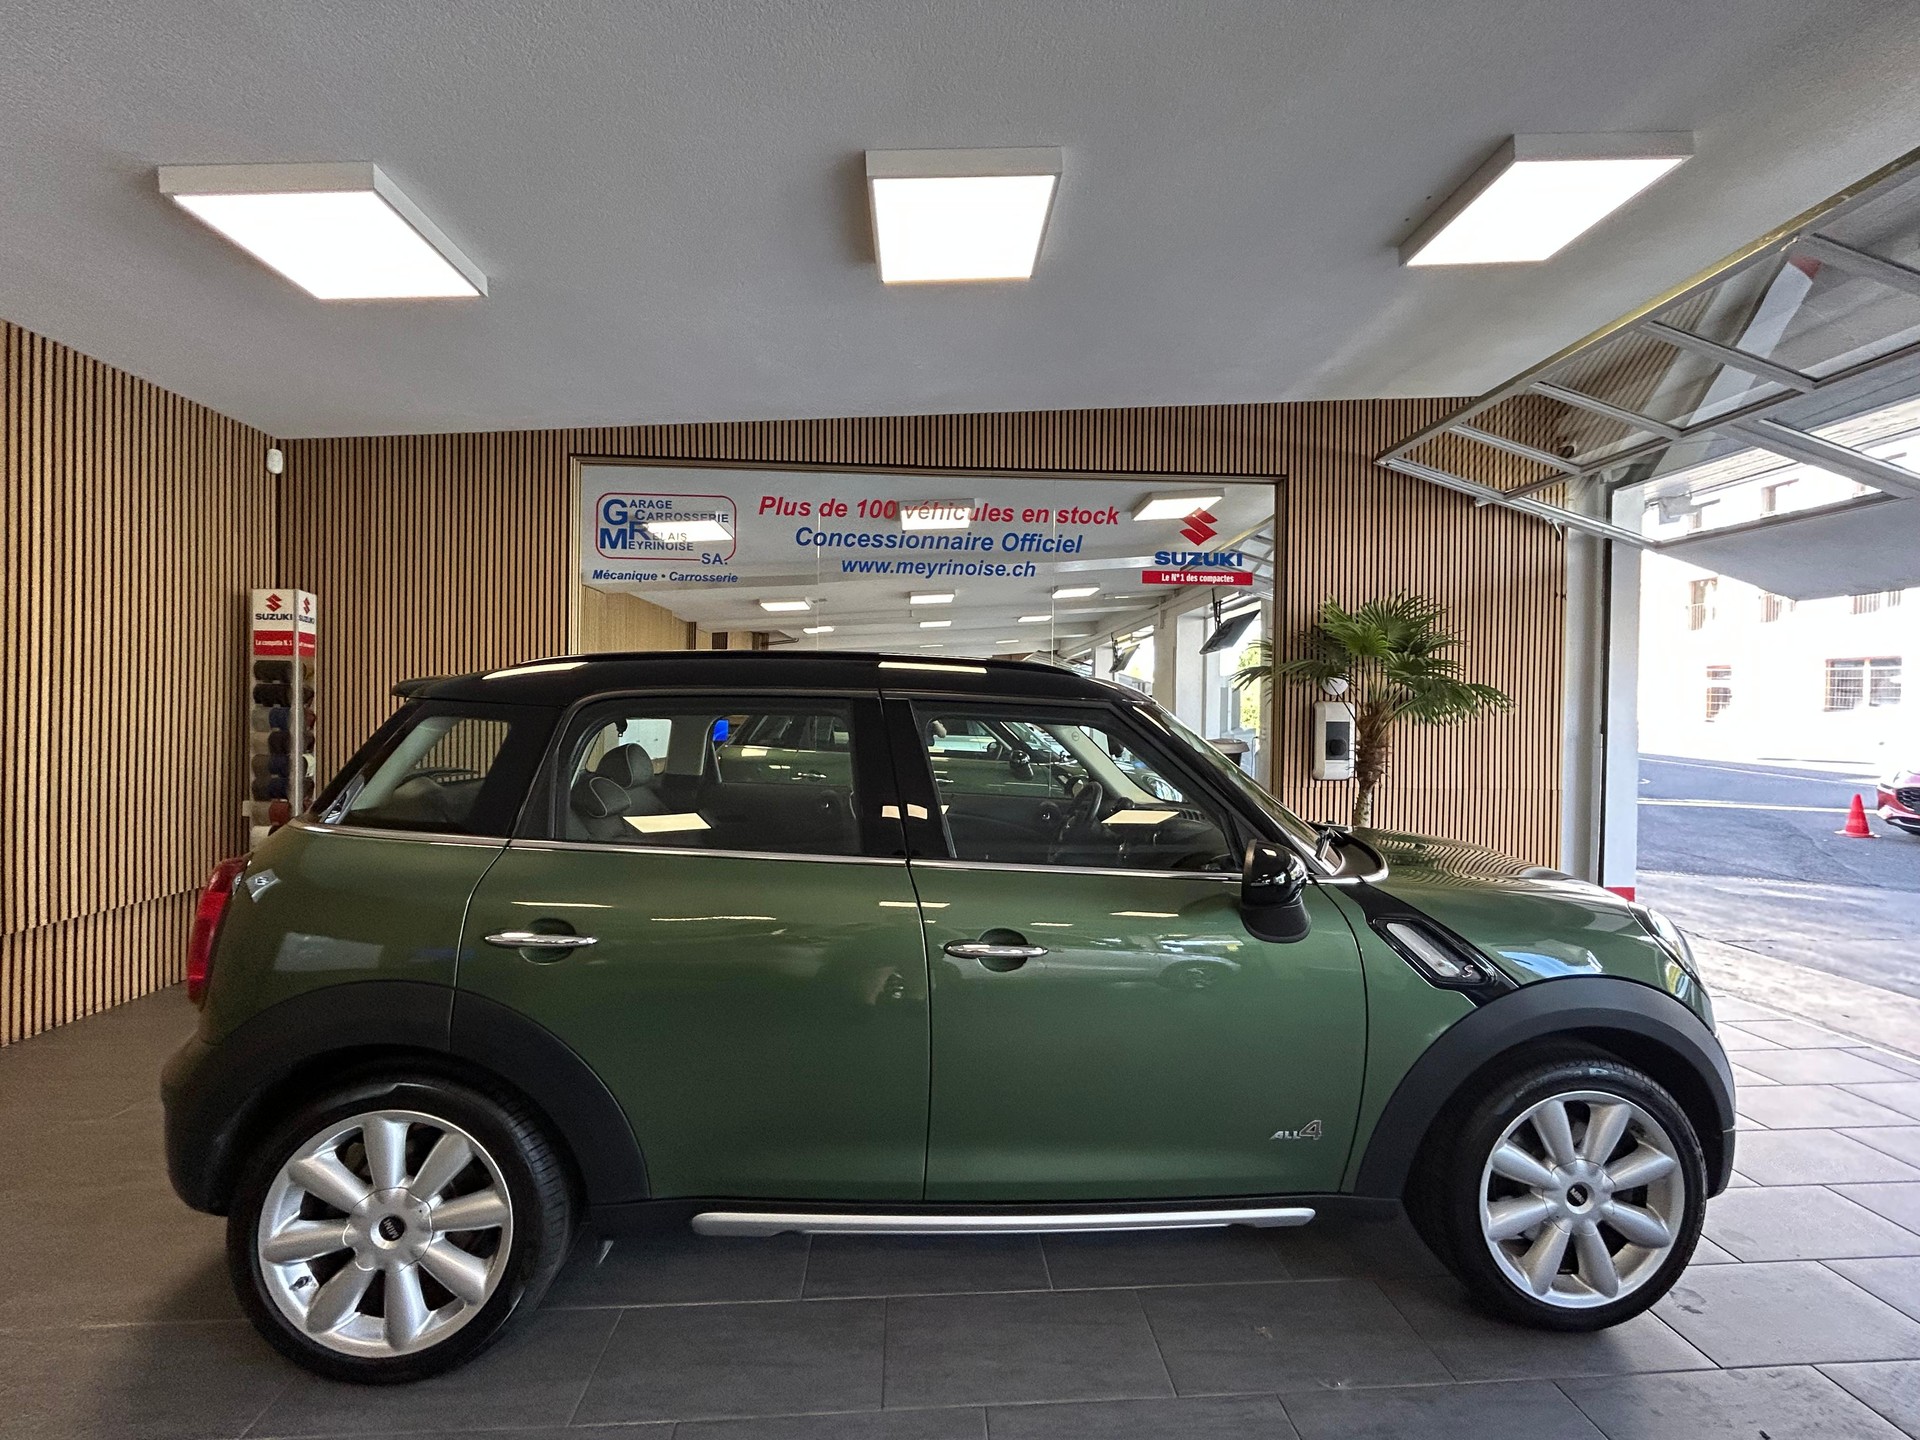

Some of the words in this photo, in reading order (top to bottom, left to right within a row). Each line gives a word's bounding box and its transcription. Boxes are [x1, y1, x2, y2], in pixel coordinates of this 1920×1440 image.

[603, 499, 673, 525] GARAGE
[634, 509, 729, 523] CARROSSERIE
[758, 496, 812, 516] Plus
[819, 498, 848, 517] de
[857, 499, 897, 519] 100
[904, 500, 1014, 522] véhicules
[1022, 507, 1049, 523] en
[1056, 506, 1120, 525] stock
[600, 528, 694, 551] MEYRINOISE
[795, 526, 994, 551] Concessionnaire
[1001, 532, 1083, 554] Officiel
[841, 559, 1036, 579] www.meyrinoise.ch
[1154, 551, 1243, 567] SUZUKI
[592, 569, 658, 583] Mécanique
[669, 571, 738, 583] Carrosserie
[1161, 573, 1170, 582] Le
[1186, 573, 1198, 583] des
[1199, 574, 1235, 584] compactes
[255, 613, 293, 621] SUZUKI
[1269, 1119, 1322, 1141] ALL4
[383, 1218, 400, 1239] MINI
